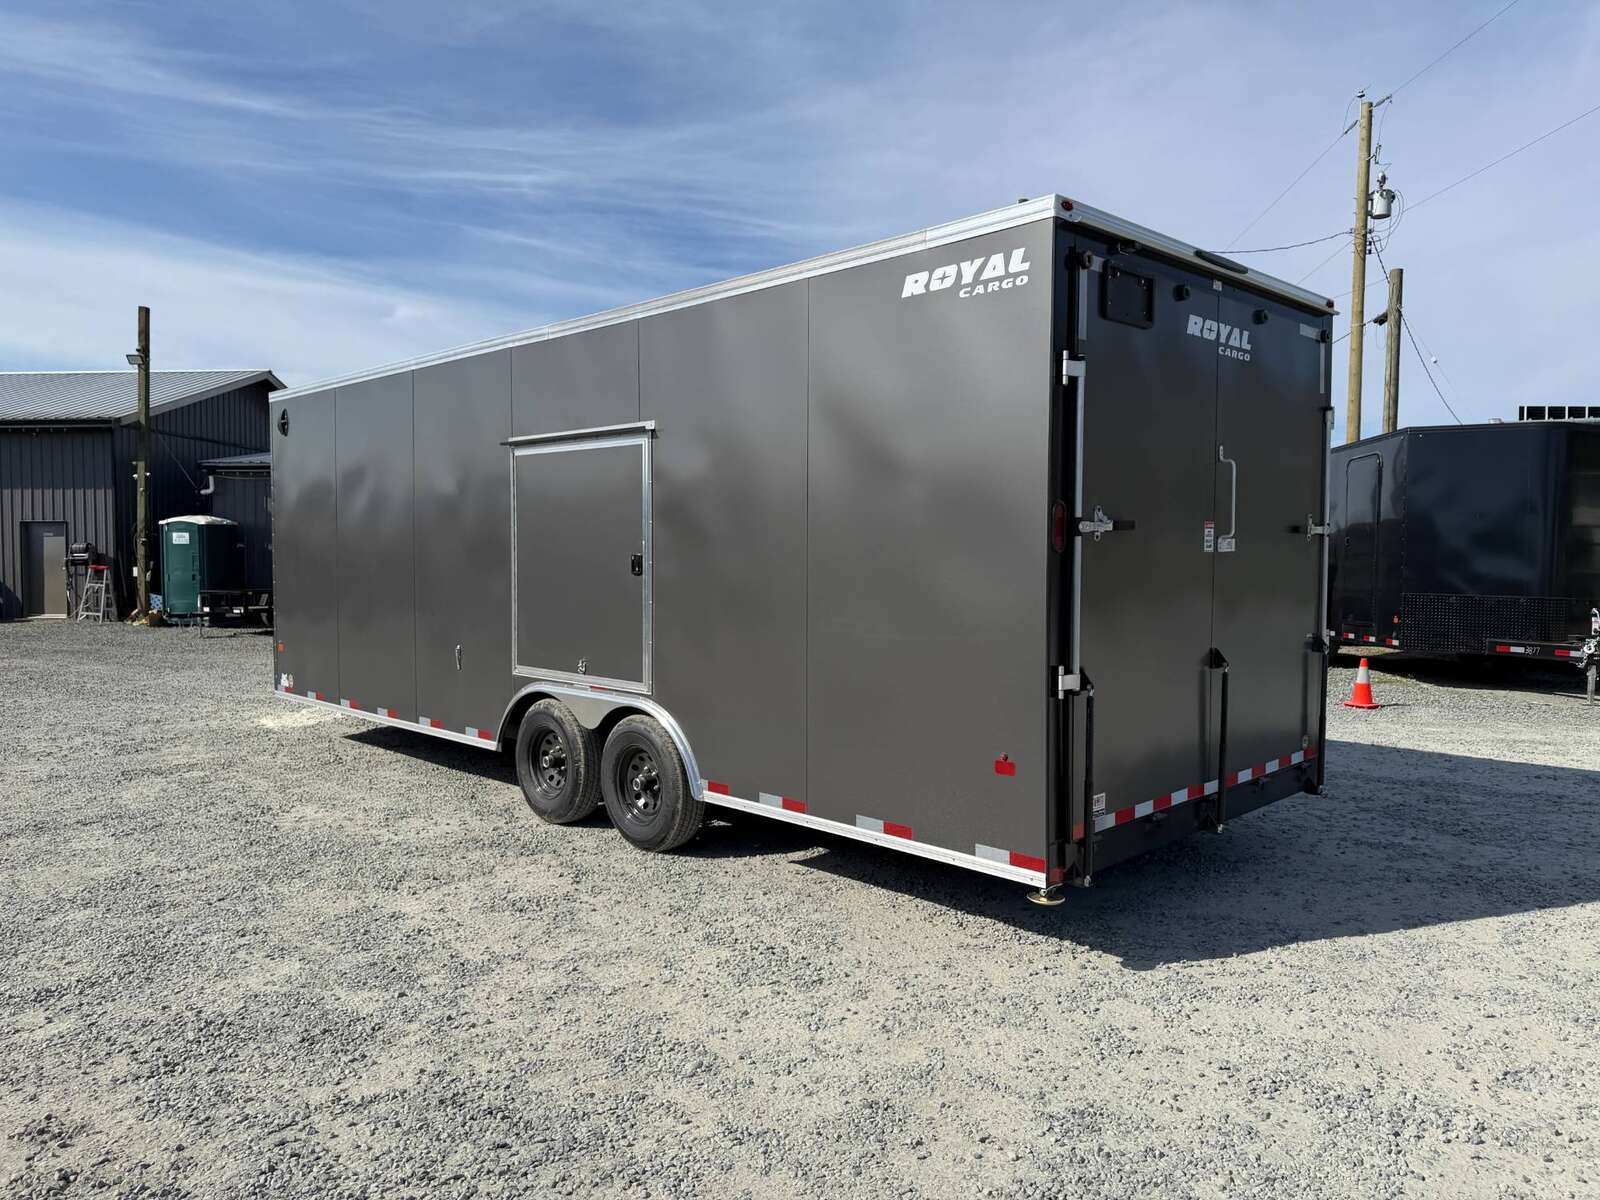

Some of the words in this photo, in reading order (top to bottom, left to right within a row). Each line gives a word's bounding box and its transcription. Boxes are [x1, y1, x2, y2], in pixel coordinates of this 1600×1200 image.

[901, 247, 1031, 298] ROYAL
[959, 275, 1029, 298] CARGO
[1186, 314, 1252, 350] ROYAL
[1218, 346, 1251, 361] CARGO
